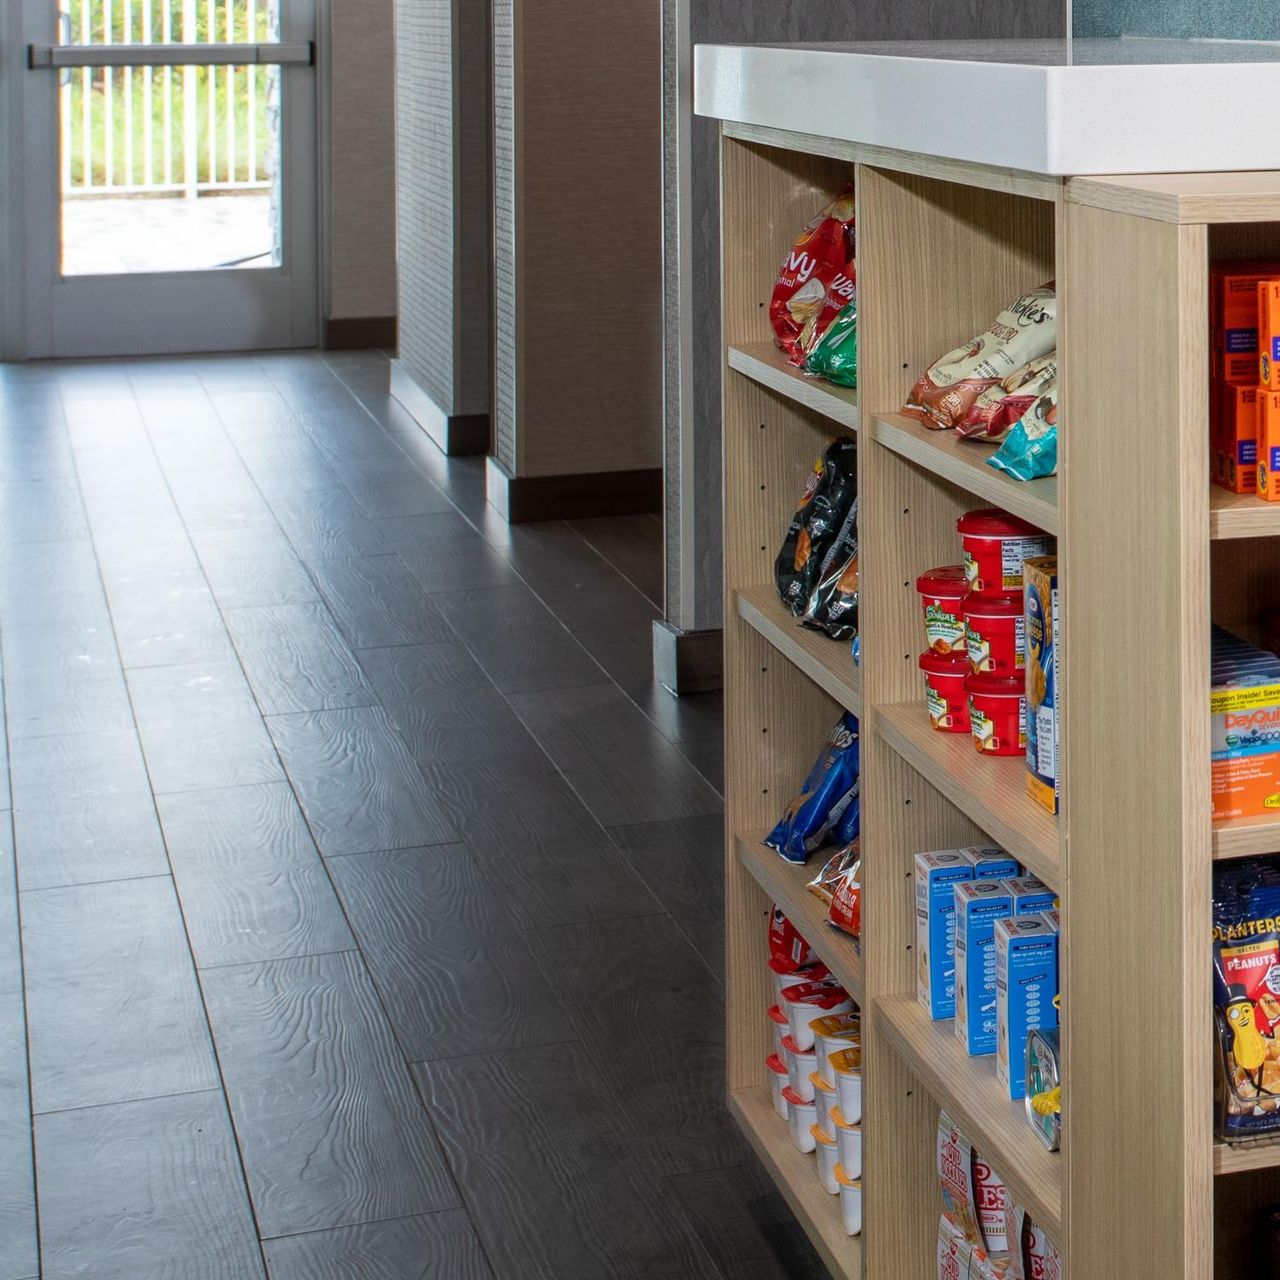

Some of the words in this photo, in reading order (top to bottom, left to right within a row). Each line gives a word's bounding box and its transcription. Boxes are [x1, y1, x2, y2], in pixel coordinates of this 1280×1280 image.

[1211, 695, 1235, 705] oupon
[1237, 691, 1262, 700] Inside!
[1263, 689, 1280, 698] Save
[1237, 945, 1261, 954] SALTED
[1227, 953, 1277, 971] PEANUTS
